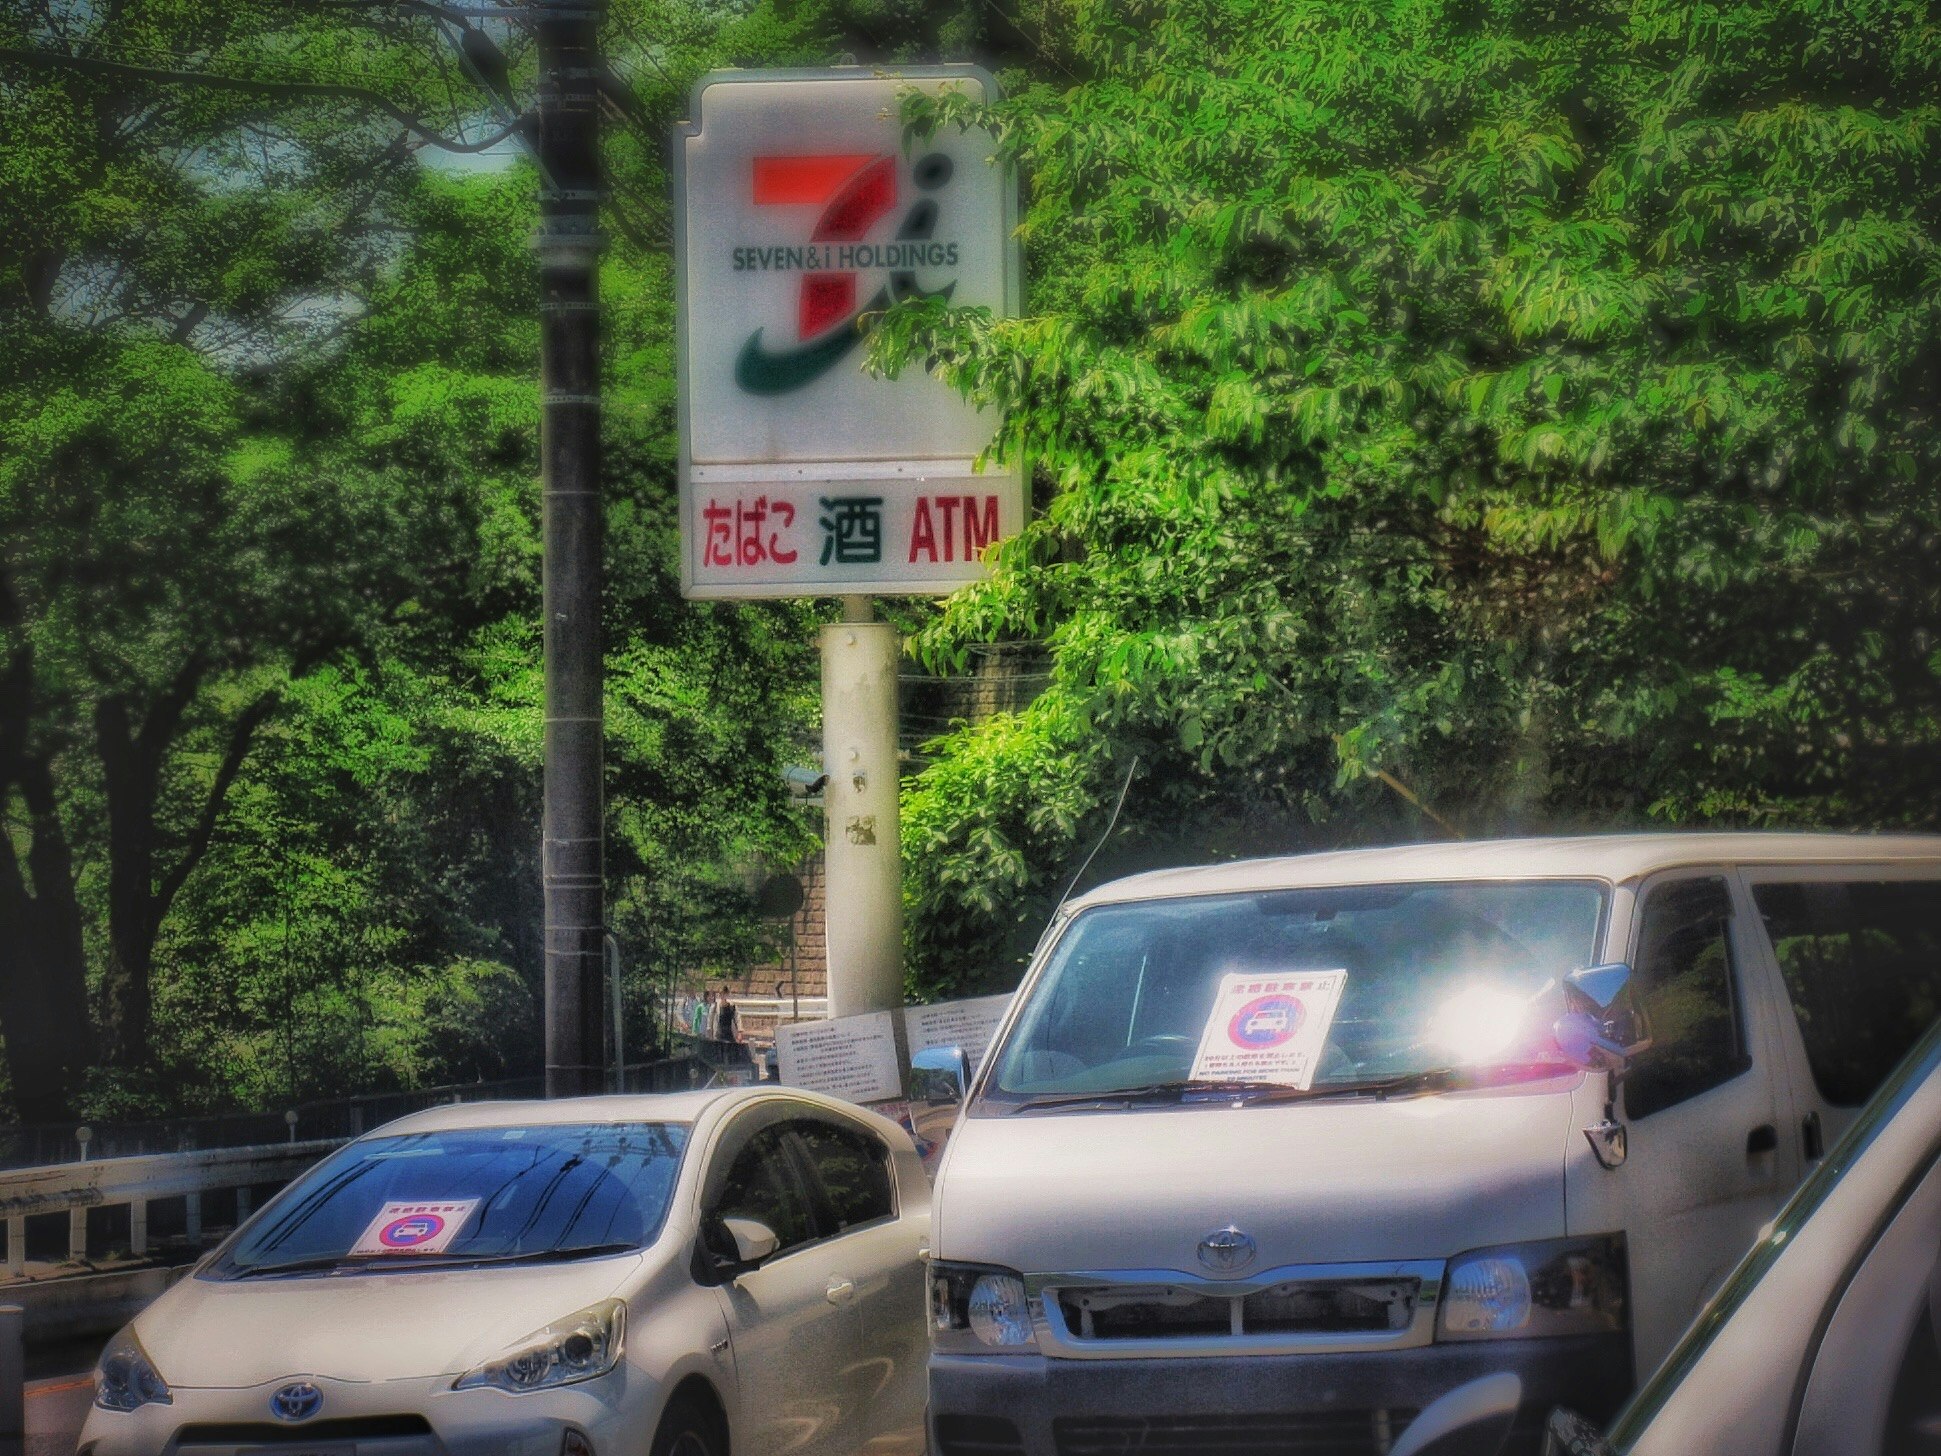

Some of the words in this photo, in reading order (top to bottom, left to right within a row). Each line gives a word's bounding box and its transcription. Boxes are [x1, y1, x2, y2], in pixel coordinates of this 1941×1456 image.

[838, 240, 959, 269] HOLDINGS
[703, 495, 798, 567] たばこ
[819, 495, 883, 566] 酒
[908, 494, 1000, 563] ATM
